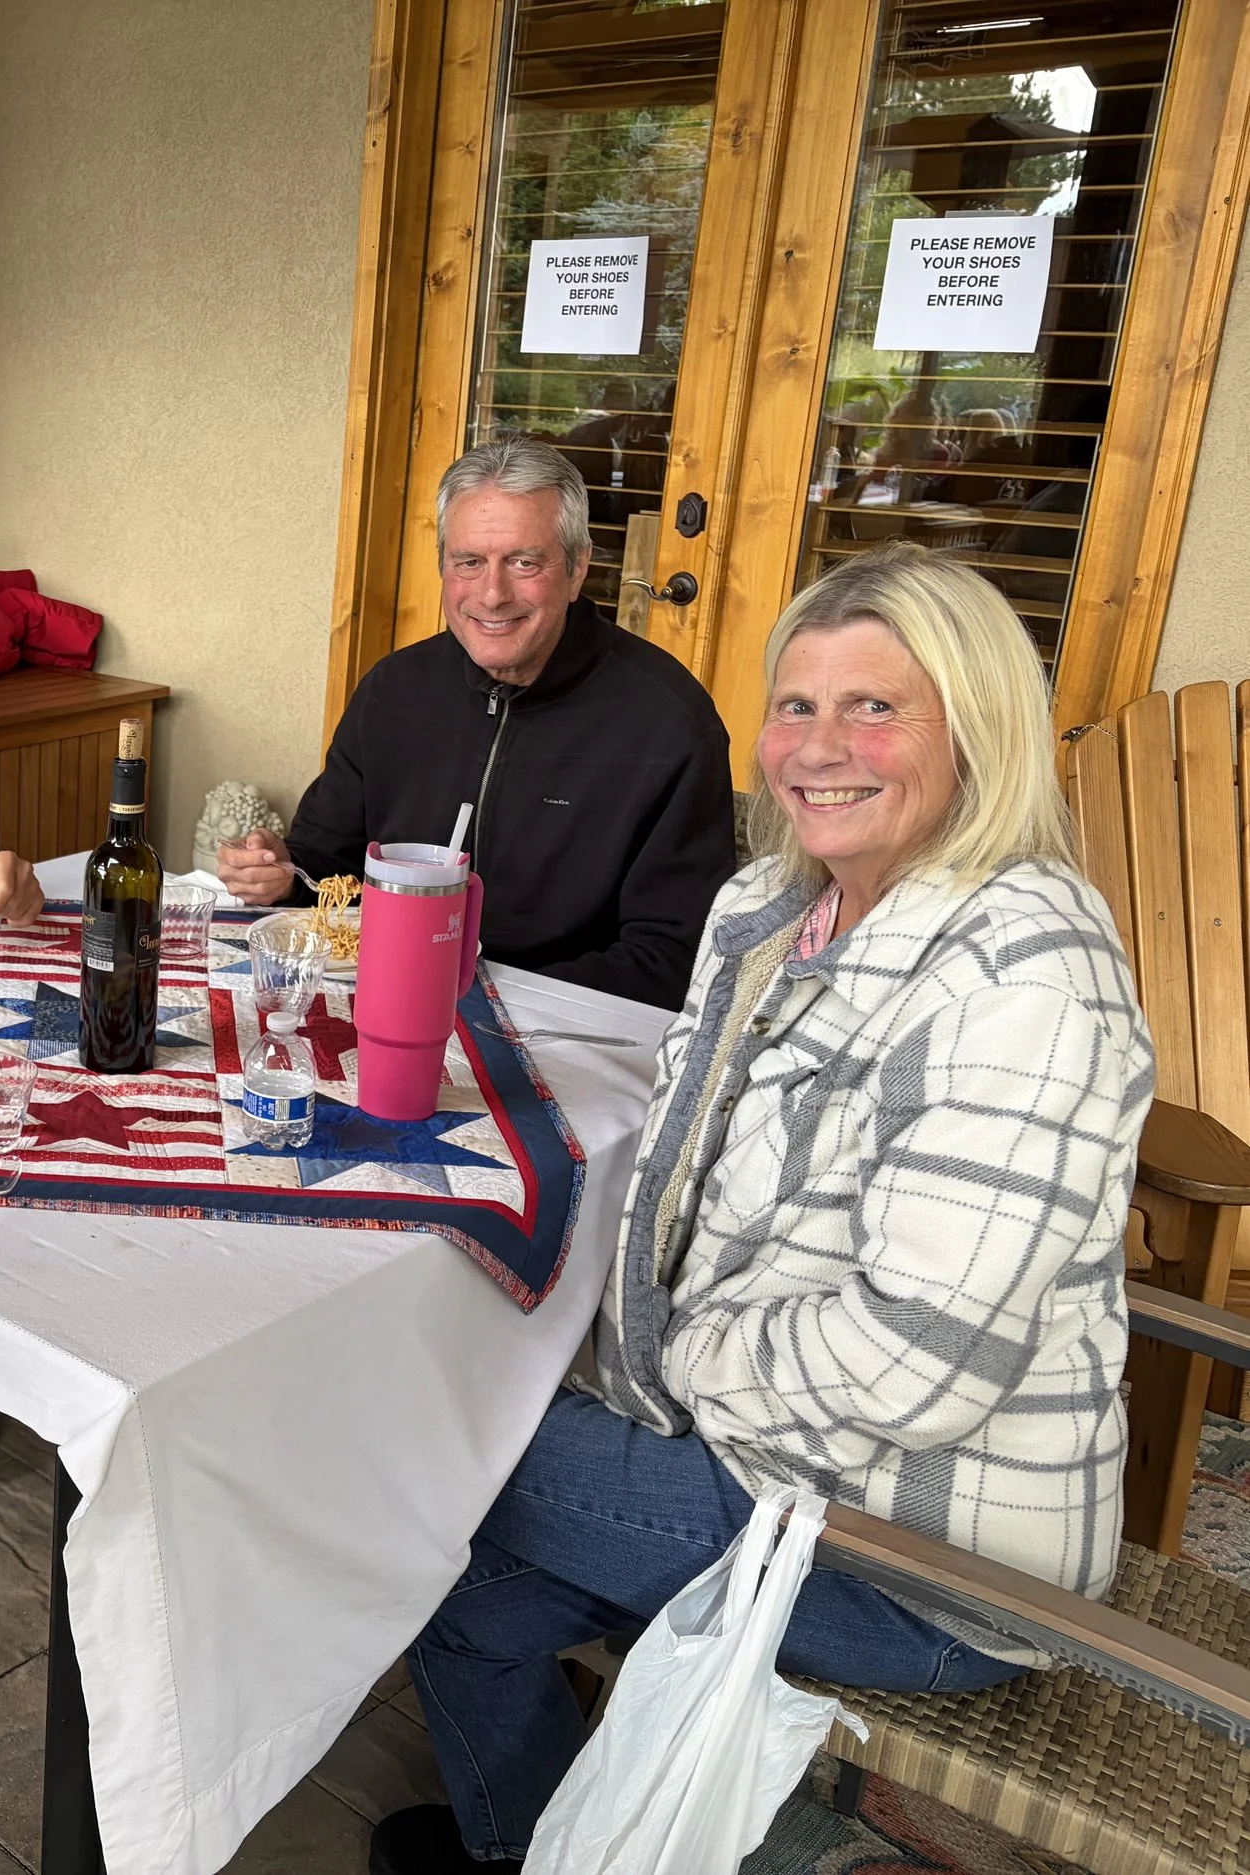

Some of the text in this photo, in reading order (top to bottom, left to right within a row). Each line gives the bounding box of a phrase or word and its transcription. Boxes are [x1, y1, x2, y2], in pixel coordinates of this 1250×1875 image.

[910, 236, 1036, 250] PLEASE REMOVE
[546, 254, 638, 267] PLEASE REMOVE
[922, 256, 1021, 269] YOUR SHOES
[556, 271, 629, 283] YOUR SHOES
[938, 275, 999, 288] BEFORE
[569, 288, 615, 299] BEFORE
[926, 294, 1003, 307] ENTERING
[561, 304, 618, 316] ENTERING
